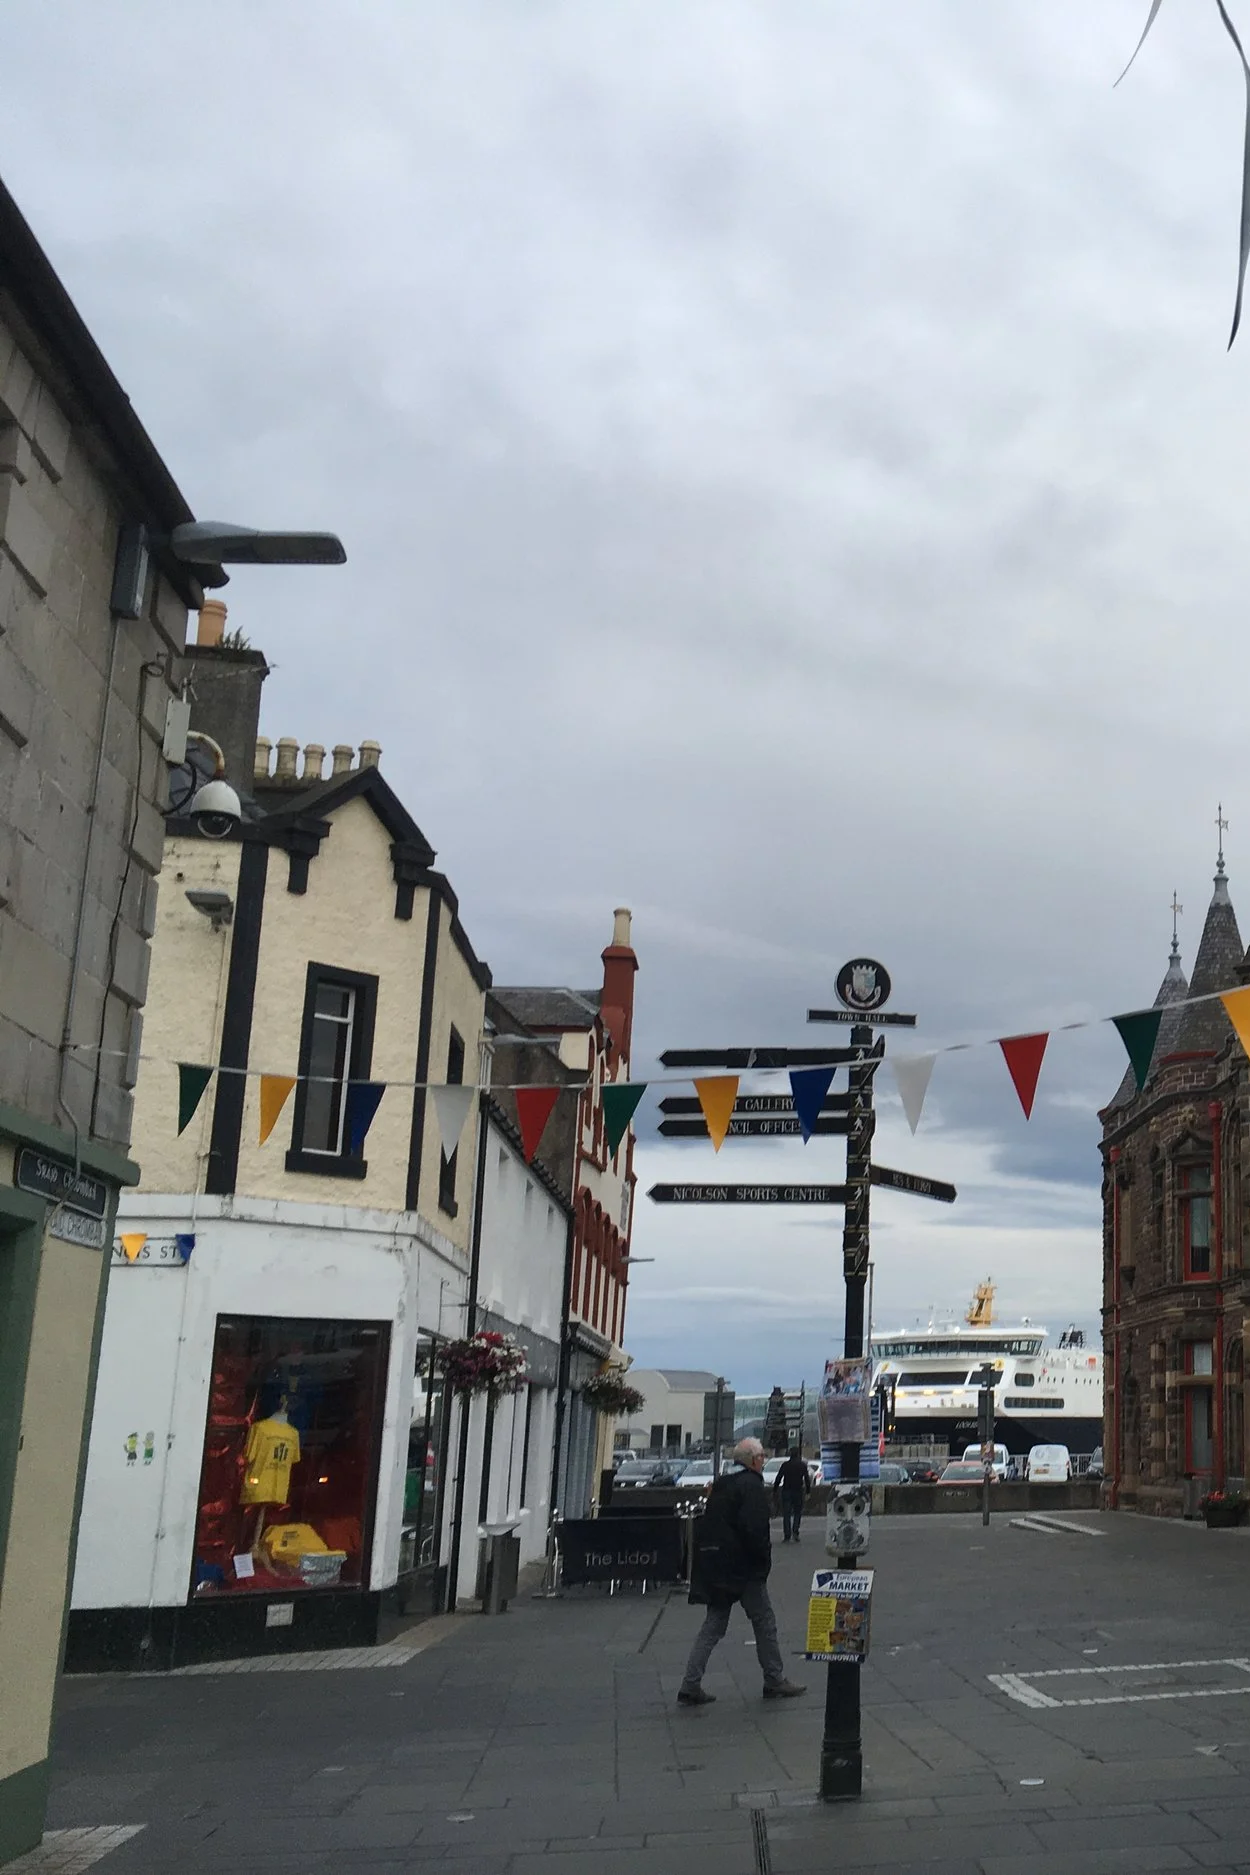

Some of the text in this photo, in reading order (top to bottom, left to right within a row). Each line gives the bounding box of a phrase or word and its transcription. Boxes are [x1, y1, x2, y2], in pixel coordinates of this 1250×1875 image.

[837, 1012, 887, 1023] TOWN HALL
[745, 1097, 795, 1110] GALLERY
[673, 1187, 829, 1200] NICOLSON SPORTS CENTRE
[160, 1245, 177, 1259] ST
[584, 1551, 612, 1567] The
[617, 1550, 650, 1565] Lido
[829, 1581, 869, 1591] MARKET
[811, 1653, 859, 1662] STORNOWAY
